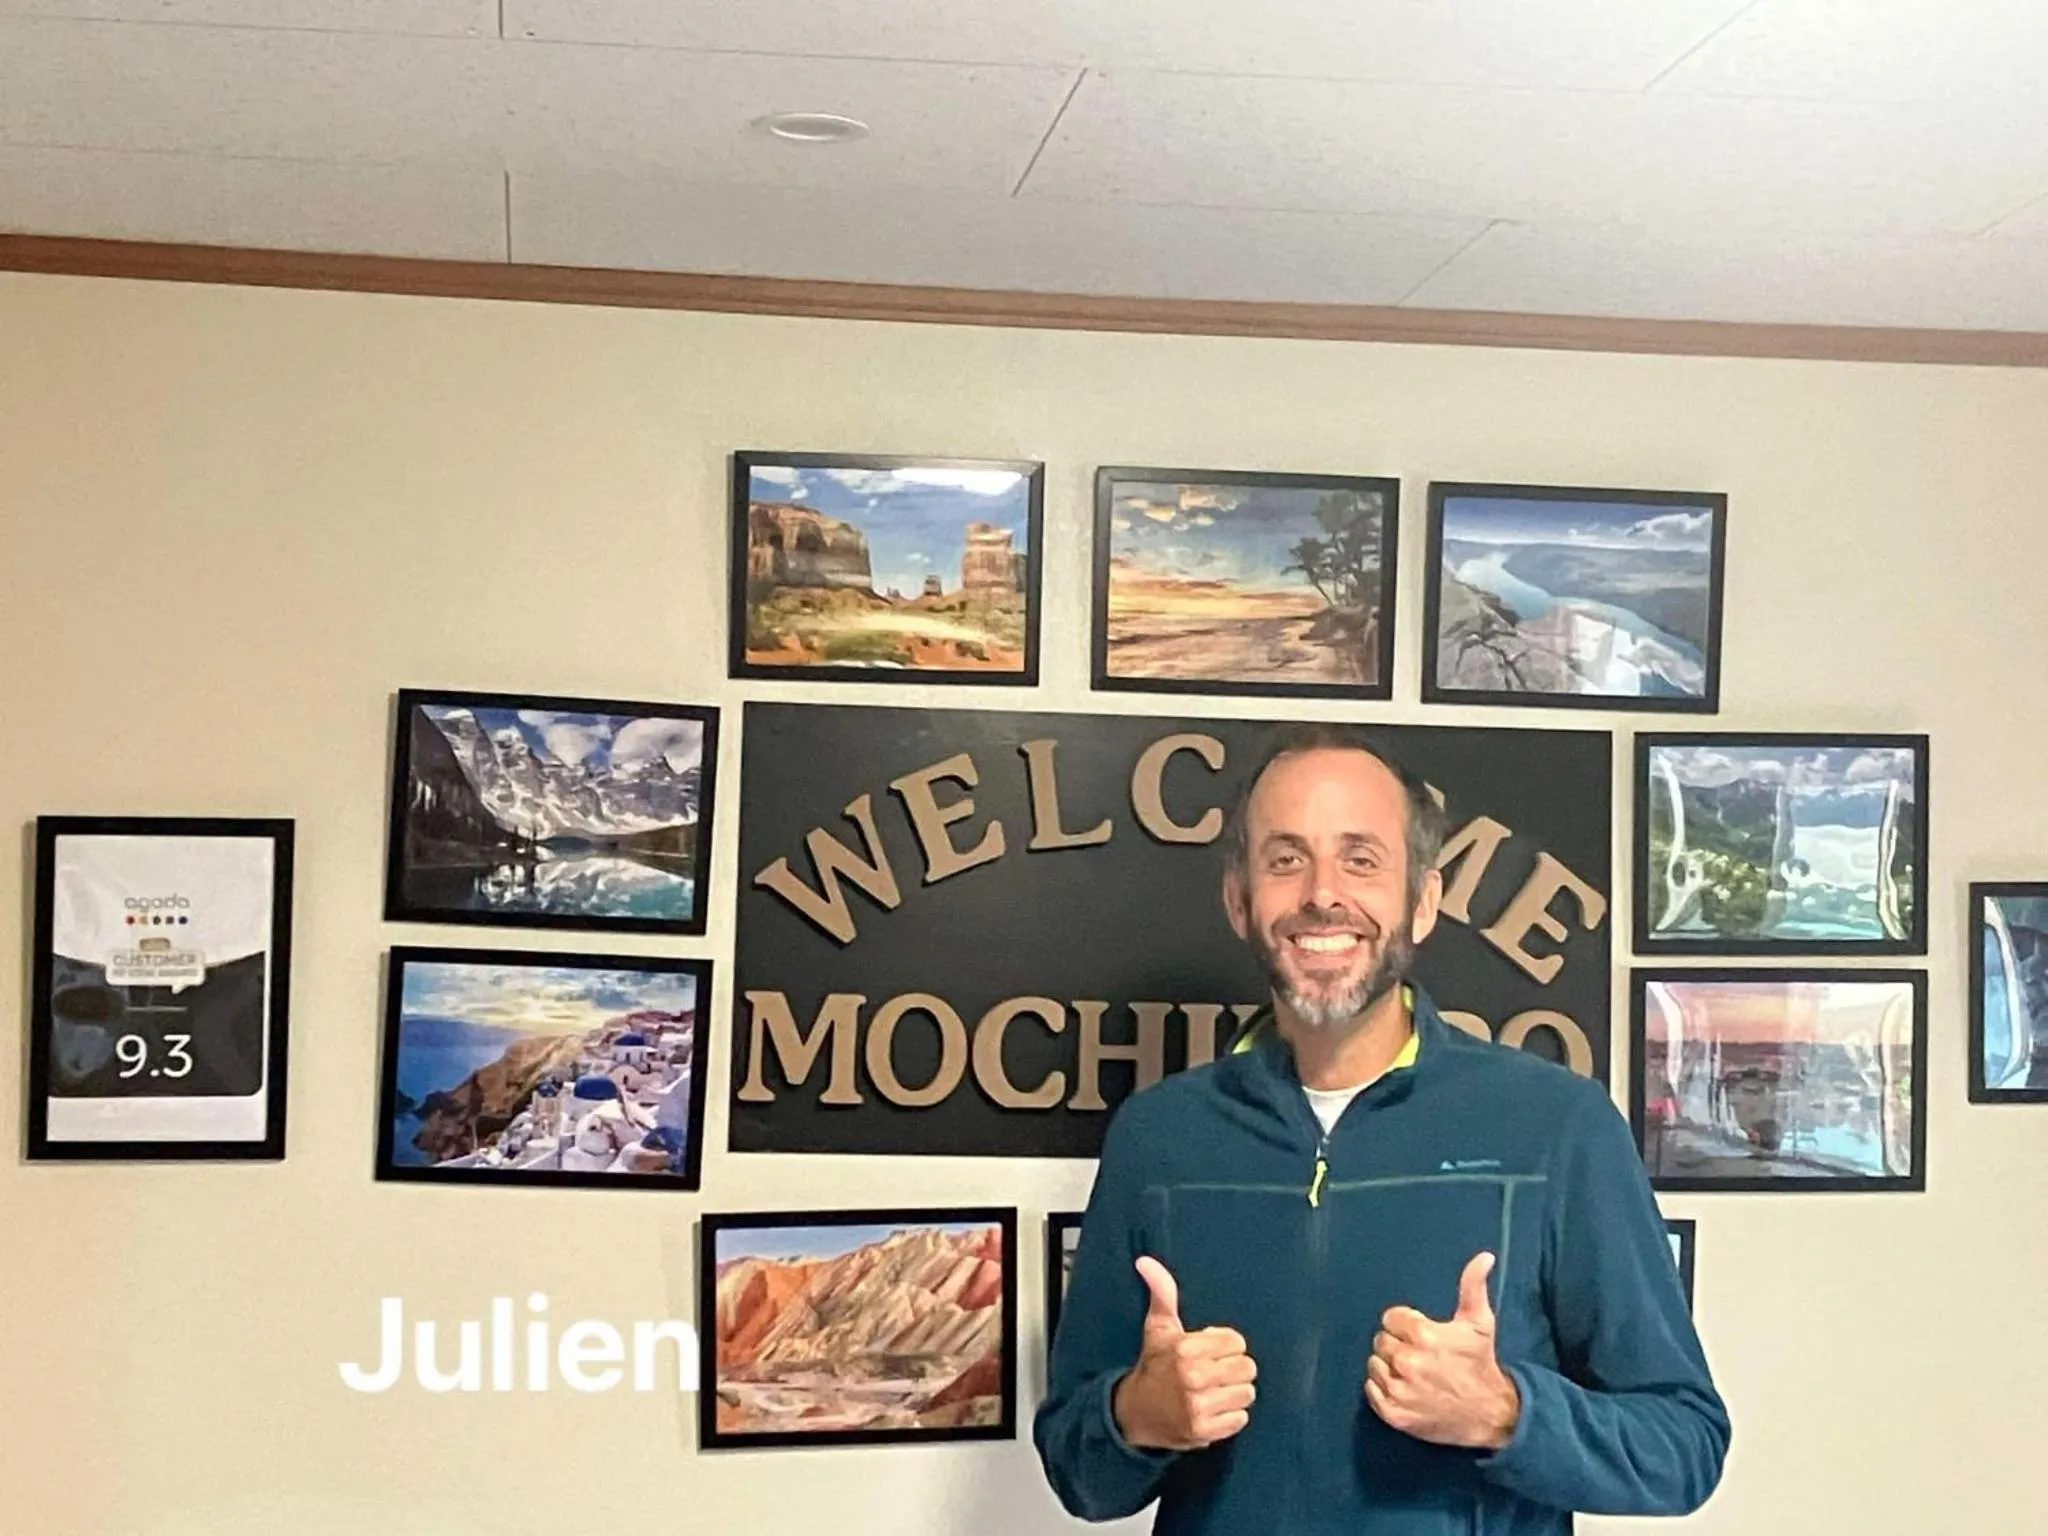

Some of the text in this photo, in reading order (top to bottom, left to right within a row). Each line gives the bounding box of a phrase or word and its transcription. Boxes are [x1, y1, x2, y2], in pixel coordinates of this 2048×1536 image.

[755, 732, 1606, 983] WELCME
[124, 893, 190, 912] agoda
[115, 1034, 193, 1078] 9.3
